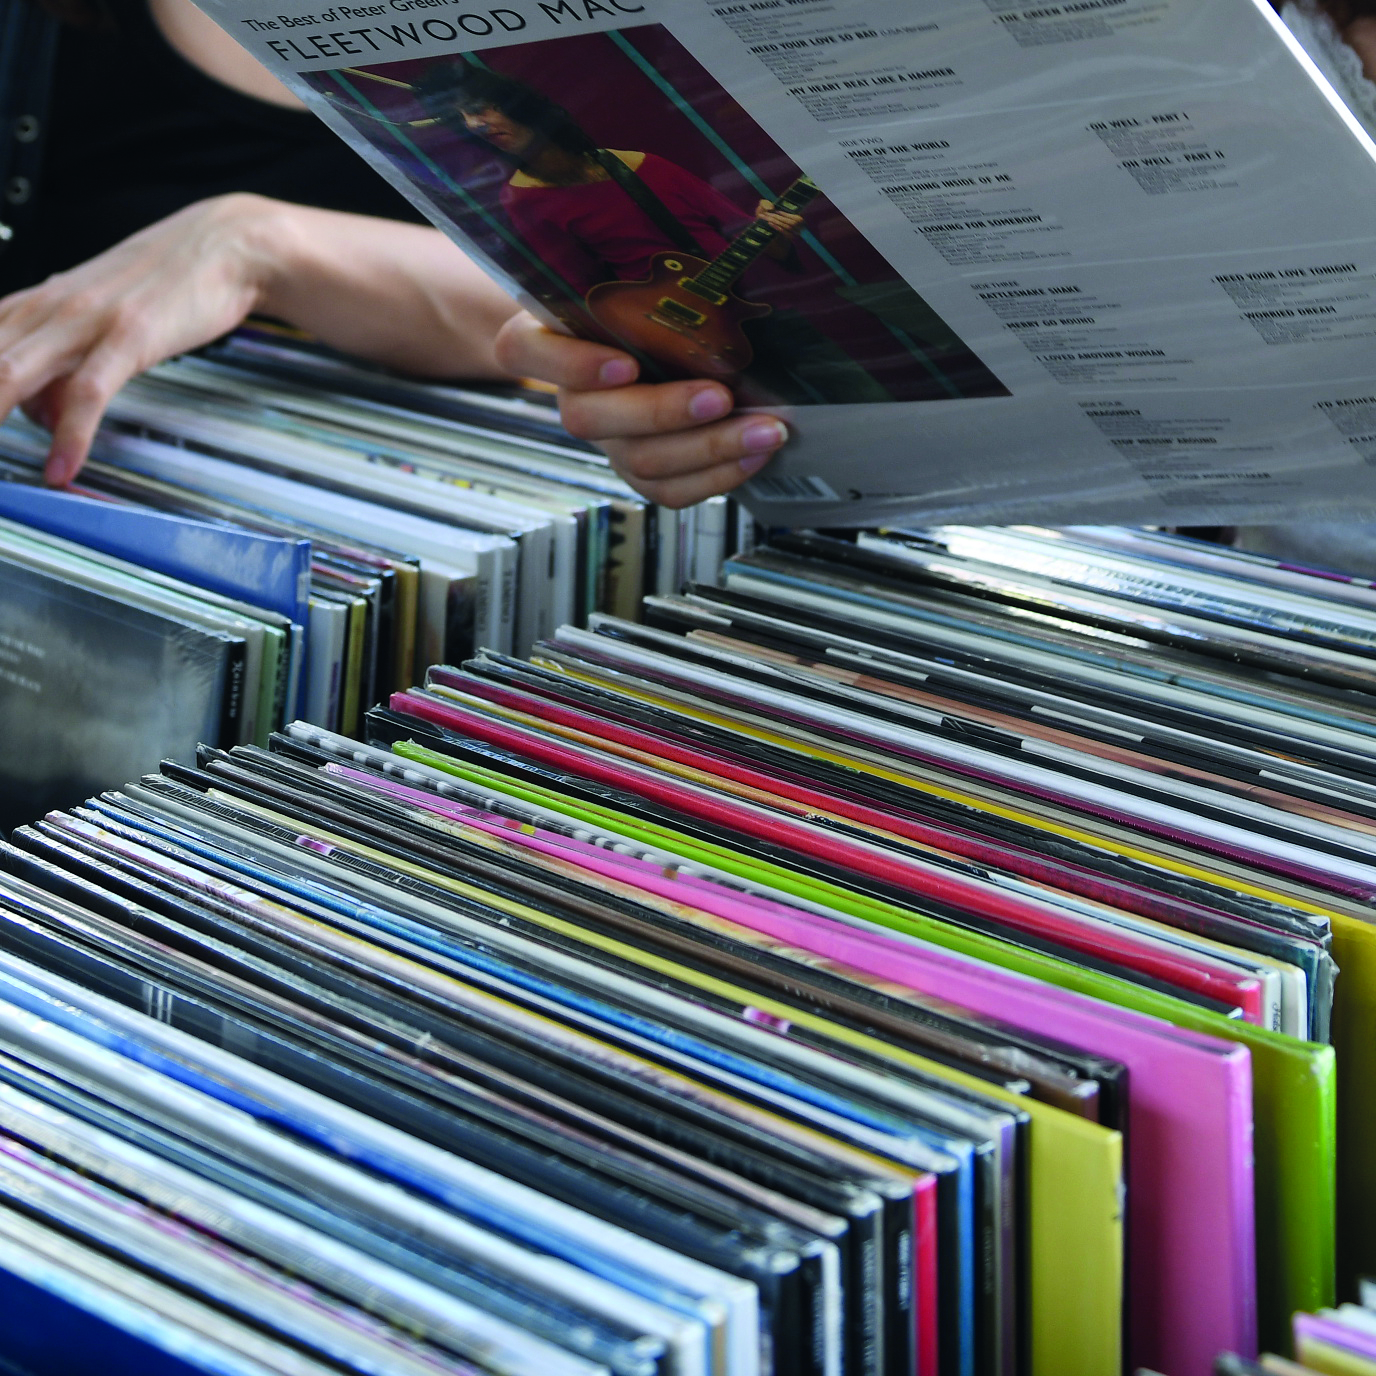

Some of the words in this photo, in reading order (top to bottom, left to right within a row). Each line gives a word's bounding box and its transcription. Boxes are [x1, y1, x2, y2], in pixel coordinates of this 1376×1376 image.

[713, 5, 749, 16] BLACK
[749, 0, 785, 10] MAGIC
[997, 13, 1019, 22] THE
[1021, 7, 1062, 18] GREEN
[241, 16, 282, 33] The
[275, 11, 322, 28] Best
[315, 8, 344, 23] of
[337, 1, 391, 19] Peter
[265, 5, 533, 63] FLEETWOOD
[749, 43, 780, 53] NEED
[778, 39, 809, 49] YOUR
[808, 36, 838, 45] LOVE
[837, 33, 855, 41] SO
[854, 30, 879, 39] BAD
[787, 86, 807, 95] MY
[806, 82, 842, 92] HEART
[842, 78, 871, 88] BEAT
[870, 75, 897, 85] LIKE
[905, 67, 956, 80] HAMMER
[1088, 122, 1108, 130] OH
[1108, 118, 1140, 128] WELL
[1150, 113, 1181, 123] PART
[846, 149, 873, 158] MAN
[872, 147, 889, 155] OF
[886, 145, 911, 153] THE
[909, 140, 952, 151] WORLD
[1120, 160, 1140, 168] OH
[1140, 156, 1172, 166] WELL
[1183, 152, 1213, 162] PART
[879, 182, 942, 194] SOMETHING
[940, 177, 977, 187] INSIDE
[976, 176, 995, 184] OF
[993, 173, 1013, 182] ME
[916, 223, 965, 233] LOOKING
[963, 220, 987, 229] FOR
[985, 215, 1045, 227] SOMEBODY
[1214, 273, 1246, 282] NEED
[1244, 271, 1277, 280] YOUR
[1276, 268, 1308, 277] LOVE
[1306, 263, 1360, 275] TONIGHT
[977, 288, 1048, 299] RATTLESNAKE
[1046, 285, 1082, 294] SHAKE
[1242, 309, 1296, 318] WORRIED
[1295, 305, 1338, 315] DREAM
[1004, 320, 1041, 328] MERRY
[1058, 317, 1097, 325] ROUND
[1076, 351, 1124, 359] ANOTHER
[1124, 349, 1166, 357] WOMAN
